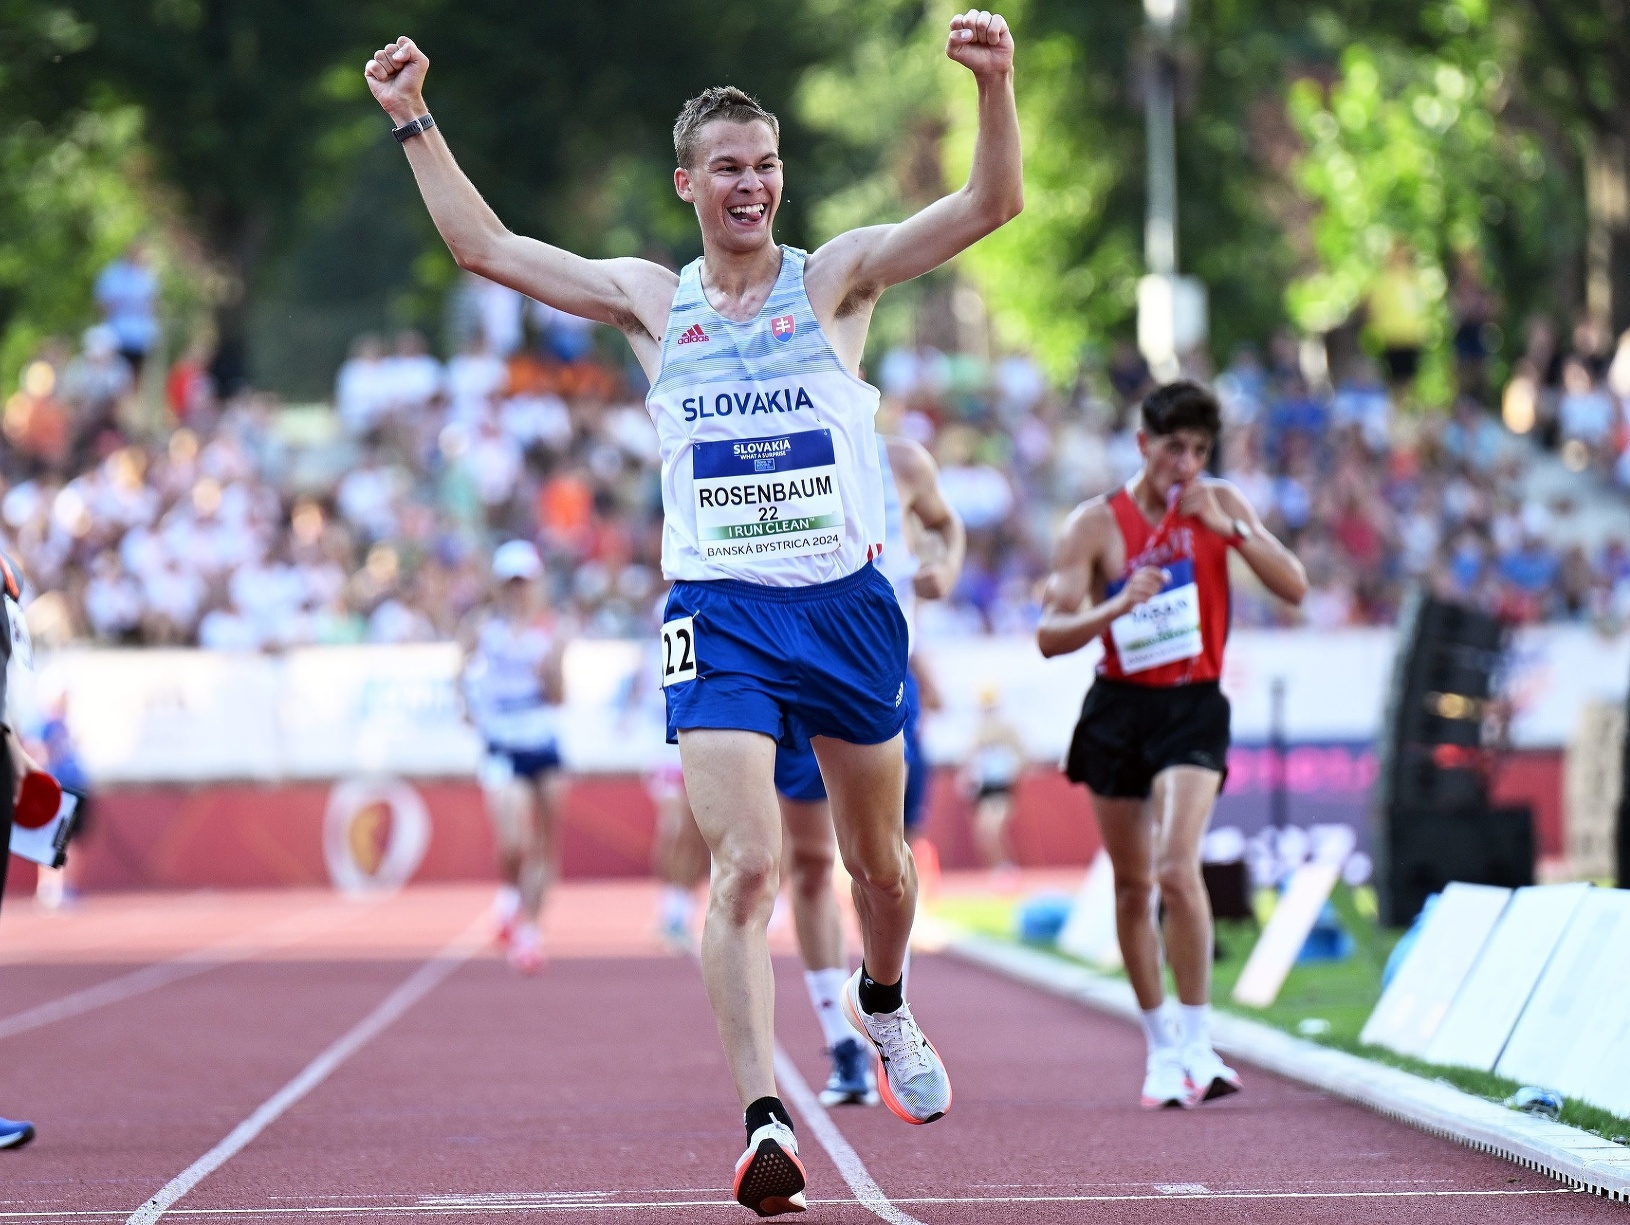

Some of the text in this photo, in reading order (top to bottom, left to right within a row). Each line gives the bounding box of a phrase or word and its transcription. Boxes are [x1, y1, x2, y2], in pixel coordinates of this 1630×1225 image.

[677, 333, 710, 345] adidas
[682, 386, 814, 422] SLOVAKIA
[733, 439, 791, 455] SLOVAKIA
[762, 450, 786, 458] SURPRISE
[699, 475, 833, 508] ROSENBAUM
[758, 506, 779, 522] 22
[728, 526, 733, 538] I
[734, 522, 763, 538] RUN
[707, 534, 839, 557] BANSKÁ BYSTRICA 2024
[664, 628, 694, 677] 22
